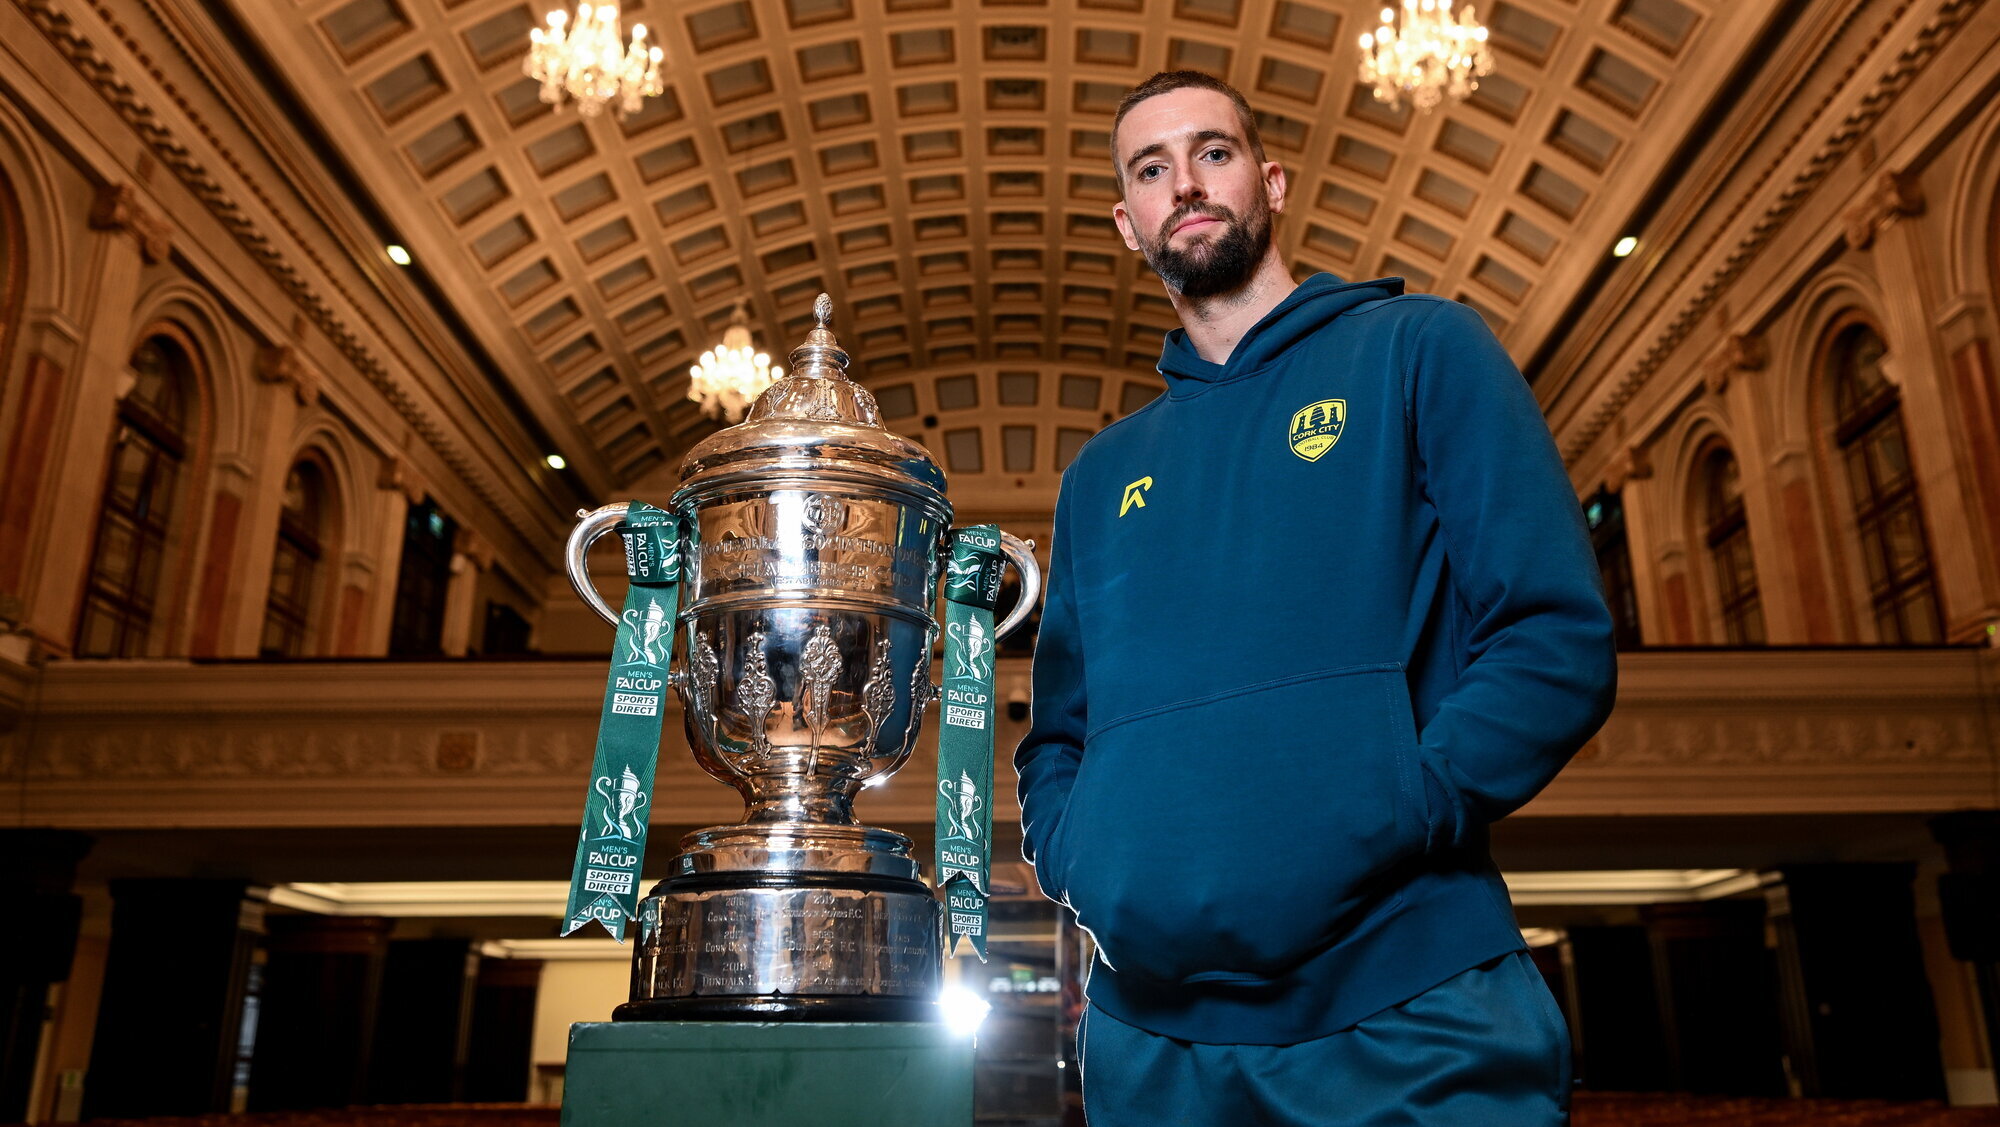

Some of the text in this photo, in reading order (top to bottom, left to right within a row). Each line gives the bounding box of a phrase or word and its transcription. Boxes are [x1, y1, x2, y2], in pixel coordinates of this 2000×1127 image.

[1293, 424, 1340, 441] CORK CITY
[1304, 442, 1324, 452] 1984
[959, 534, 996, 549] FAI CUP
[637, 533, 649, 577] FAI CUP
[627, 671, 653, 679] MEN'S
[616, 677, 662, 691] FAI CUP
[957, 684, 979, 694] MEN'S
[617, 694, 655, 705] SPORTS
[948, 690, 987, 705] FAI CUP
[615, 705, 654, 715] DIRECT
[950, 707, 983, 718] SPORTS
[949, 717, 982, 728] DIRECT
[601, 845, 628, 854] MEN'S
[950, 845, 972, 855] MEN'S
[589, 852, 637, 867] FAI CUP
[942, 851, 980, 867] FAI CUP
[590, 871, 630, 882] SPORTS
[945, 869, 977, 880] SPTS
[588, 882, 628, 893] DIRECT
[957, 890, 977, 898] MEN'S
[813, 895, 835, 905] 2019
[950, 896, 984, 910] FAI CUP
[582, 906, 621, 920] AI CUP
[953, 914, 980, 925] SPORTS
